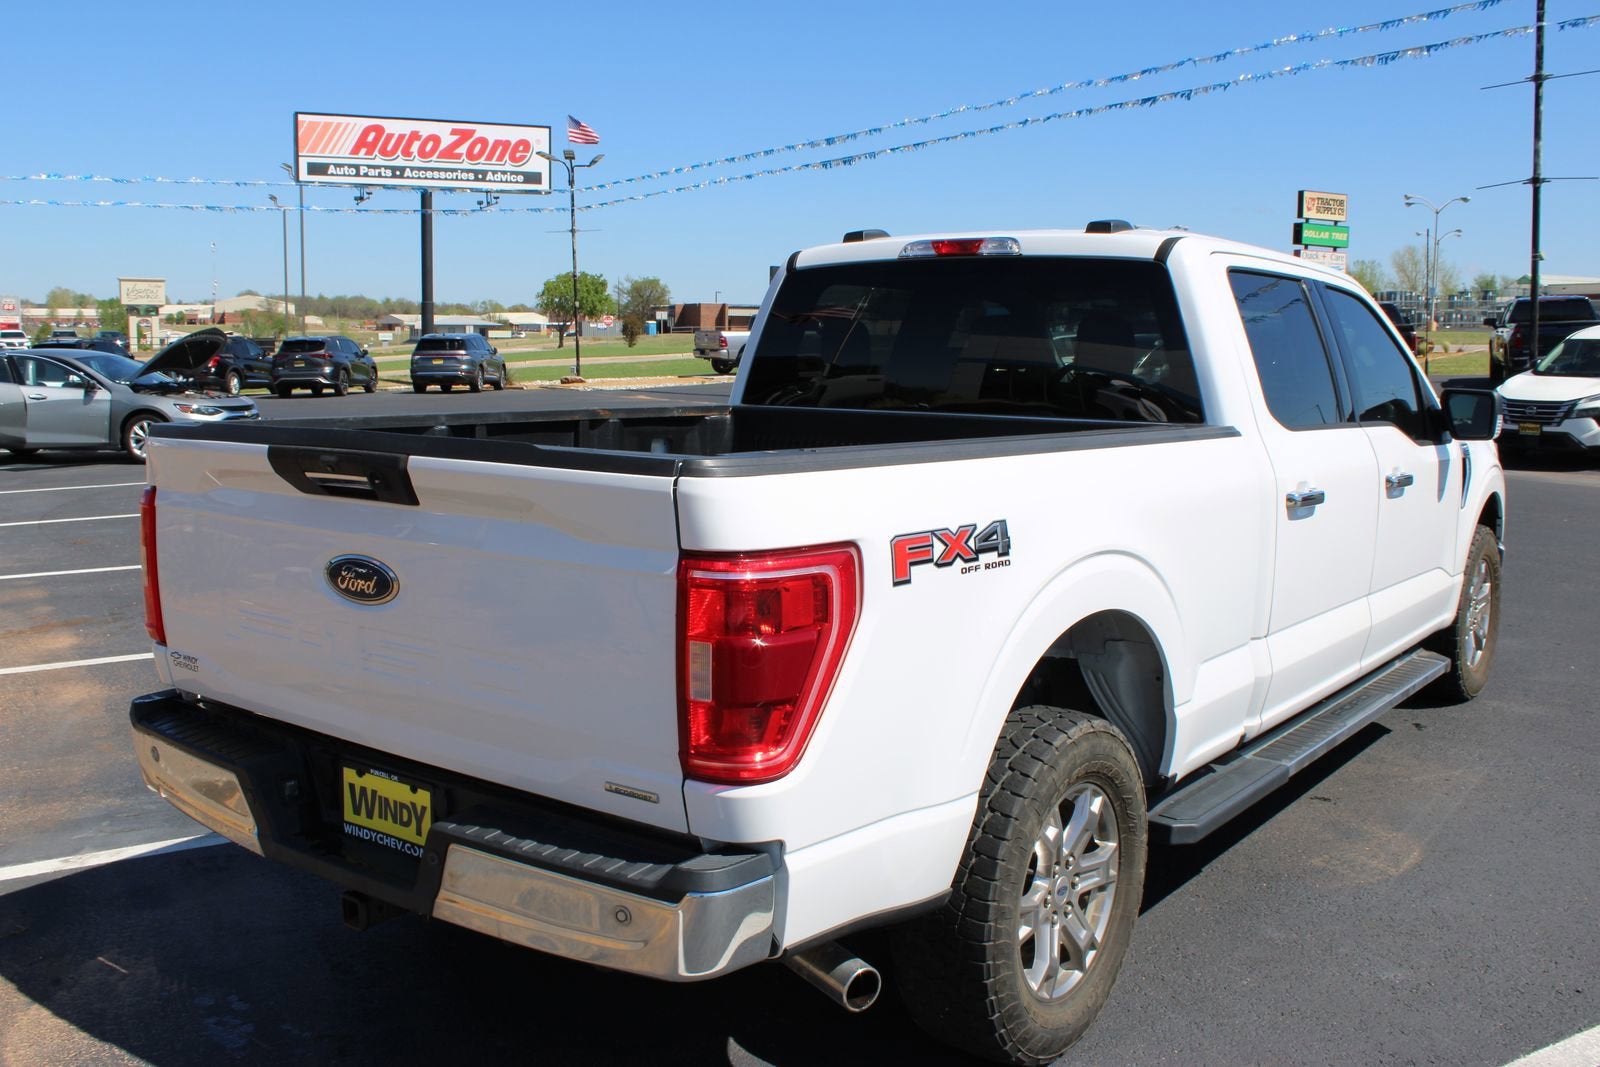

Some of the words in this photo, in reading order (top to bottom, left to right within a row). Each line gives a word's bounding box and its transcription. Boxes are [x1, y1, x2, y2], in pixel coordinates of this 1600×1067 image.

[350, 124, 533, 166] AutoZone
[327, 164, 358, 176] Auto
[359, 166, 392, 178] Parts
[403, 168, 475, 181] Accessories
[486, 171, 524, 183] Advice
[1316, 197, 1345, 207] TRACTOR
[1304, 230, 1330, 239] DOLLAR
[890, 519, 1011, 587] FX4
[961, 564, 981, 575] OFF
[984, 559, 1011, 570] ROAD
[337, 565, 377, 595] Ford
[348, 782, 427, 838] WINDY
